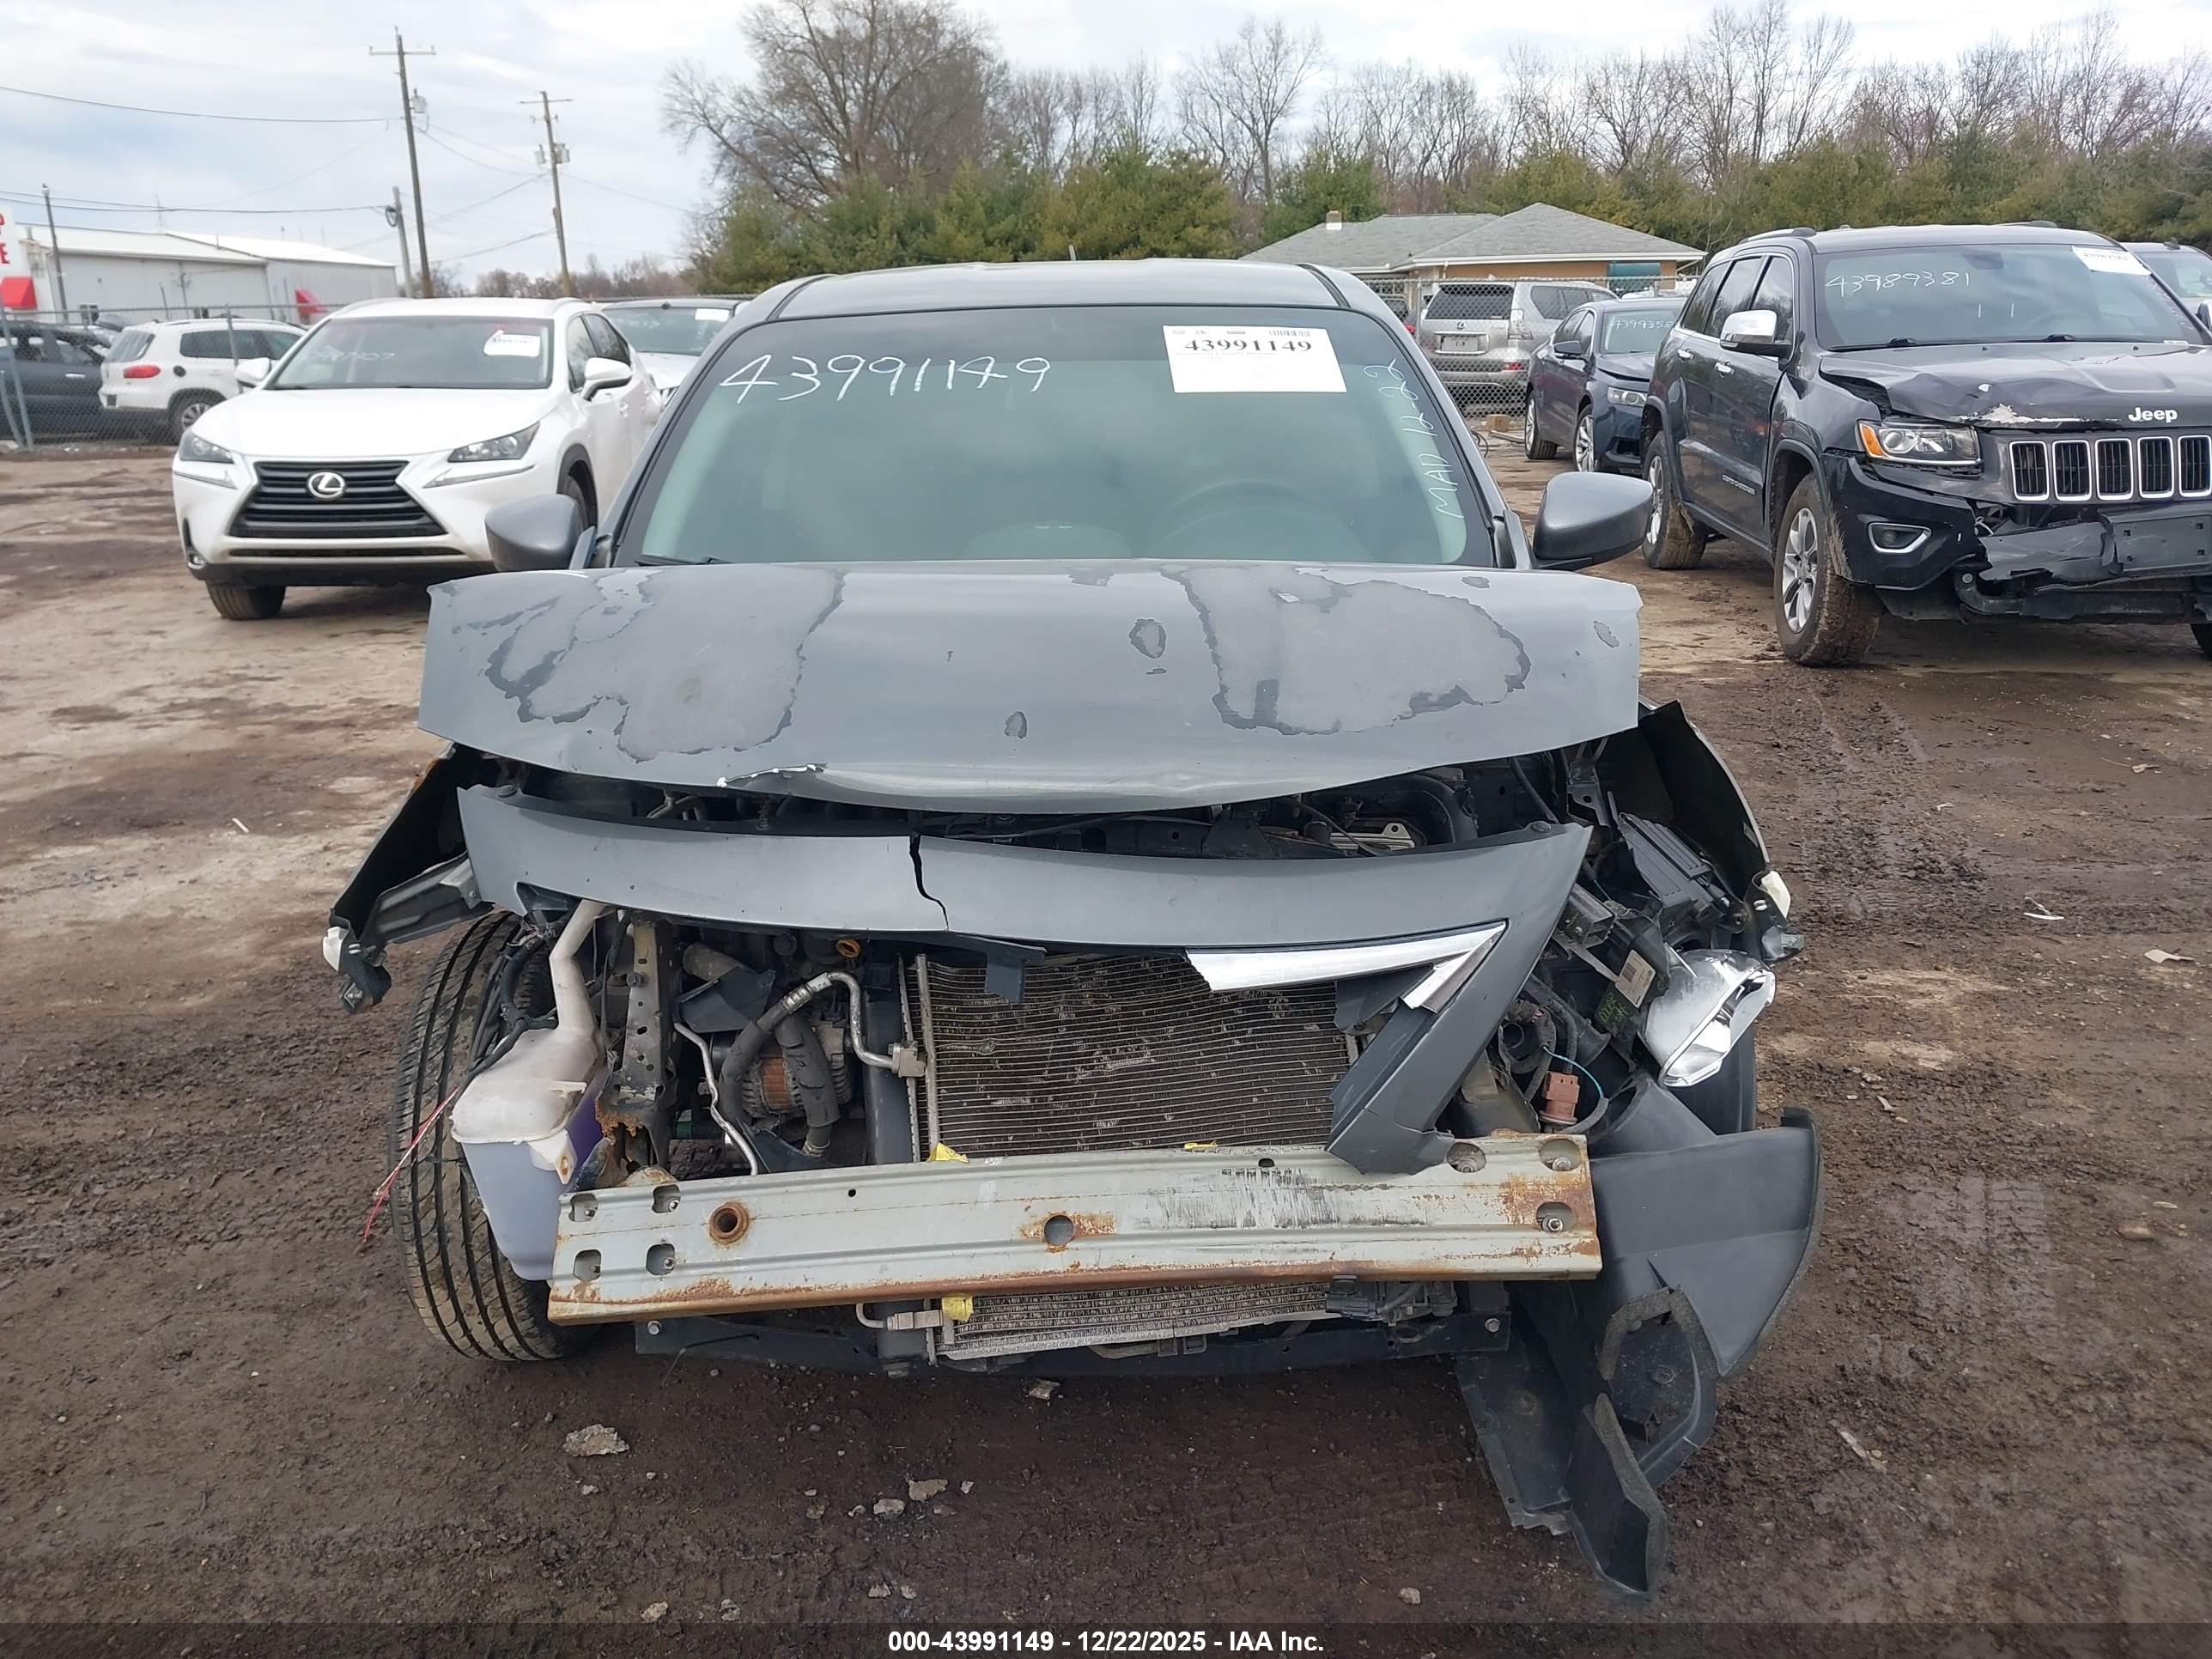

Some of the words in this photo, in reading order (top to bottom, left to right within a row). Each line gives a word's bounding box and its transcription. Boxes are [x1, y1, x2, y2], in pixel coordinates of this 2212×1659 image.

[1825, 270, 1970, 297] 43989381
[1184, 338, 1313, 352] 43991149
[720, 353, 1051, 404] 43991149
[2128, 406, 2179, 423] Jeep
